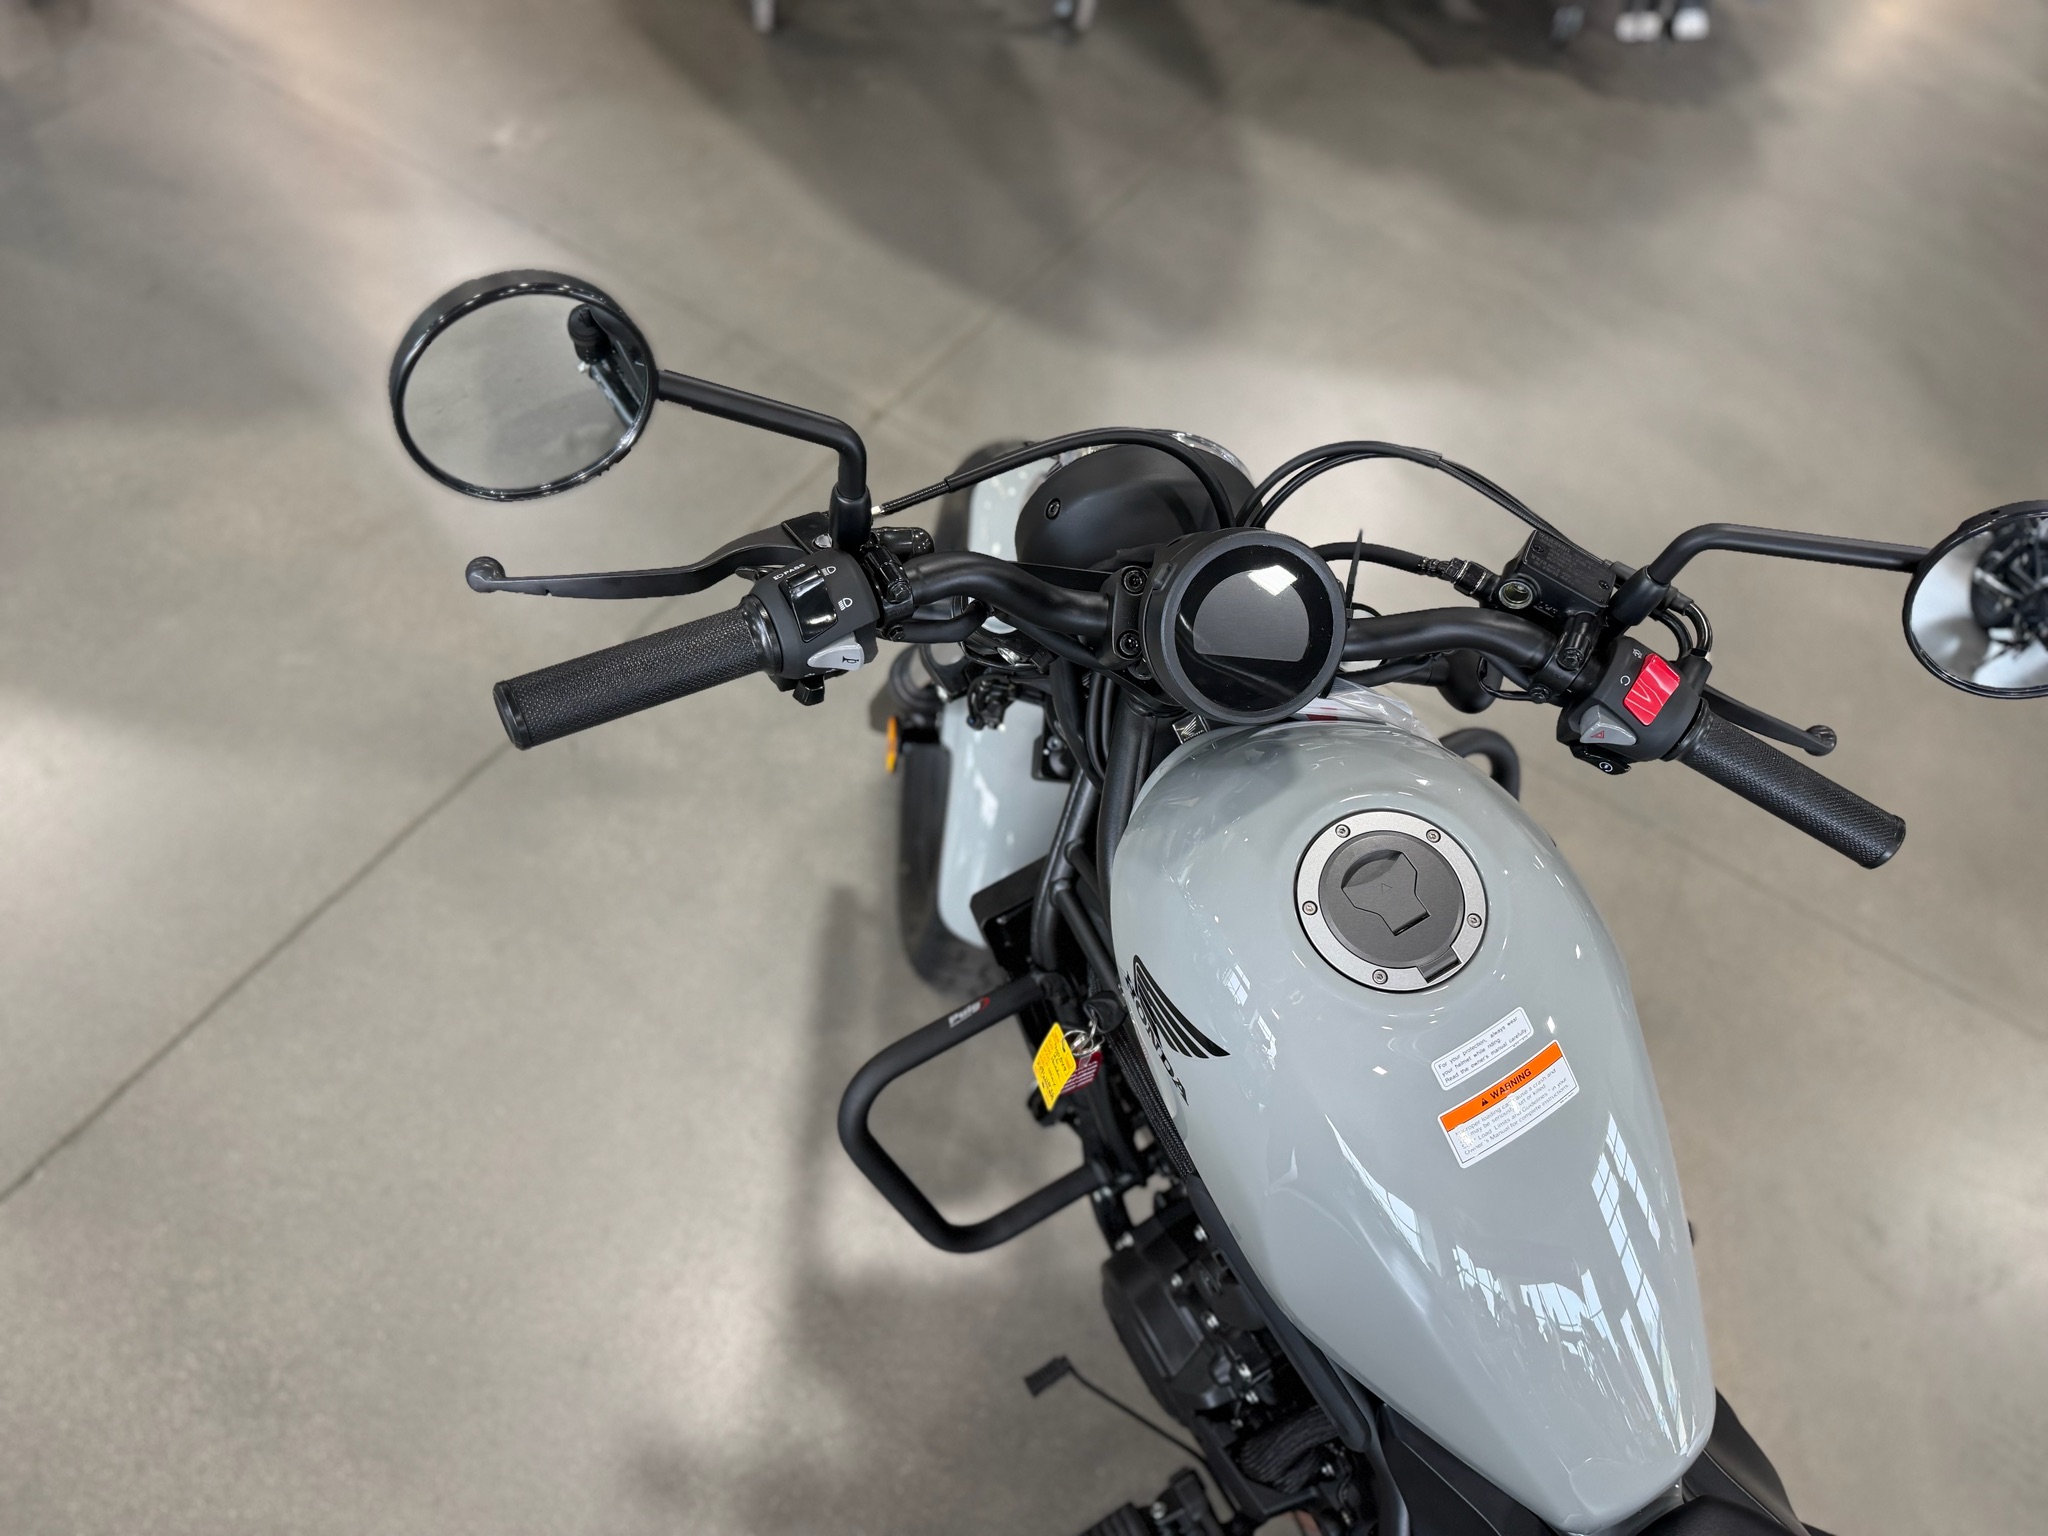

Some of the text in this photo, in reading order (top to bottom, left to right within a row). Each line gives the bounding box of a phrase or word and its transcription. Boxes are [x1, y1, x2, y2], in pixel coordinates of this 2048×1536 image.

[783, 563, 806, 576] PASS
[1438, 1061, 1448, 1070] For
[1449, 1054, 1460, 1064] your
[1490, 1026, 1506, 1038] always
[1507, 1016, 1518, 1026] wear
[1442, 1067, 1453, 1078] your
[1454, 1056, 1472, 1069] helmet
[1473, 1048, 1486, 1058] while
[1444, 1072, 1459, 1083] Read
[1460, 1066, 1469, 1075] the
[1470, 1054, 1489, 1068] owner's
[1491, 1041, 1508, 1056] manual
[1480, 1107, 1502, 1121] loading
[1532, 1076, 1547, 1088] crash
[1490, 1068, 1532, 1100] WARNING
[1470, 1127, 1483, 1136] may
[1489, 1126, 1511, 1141] Manual
[1510, 1120, 1518, 1128] for
[1519, 1104, 1541, 1122] complete
[1493, 1118, 1511, 1130] Limits
